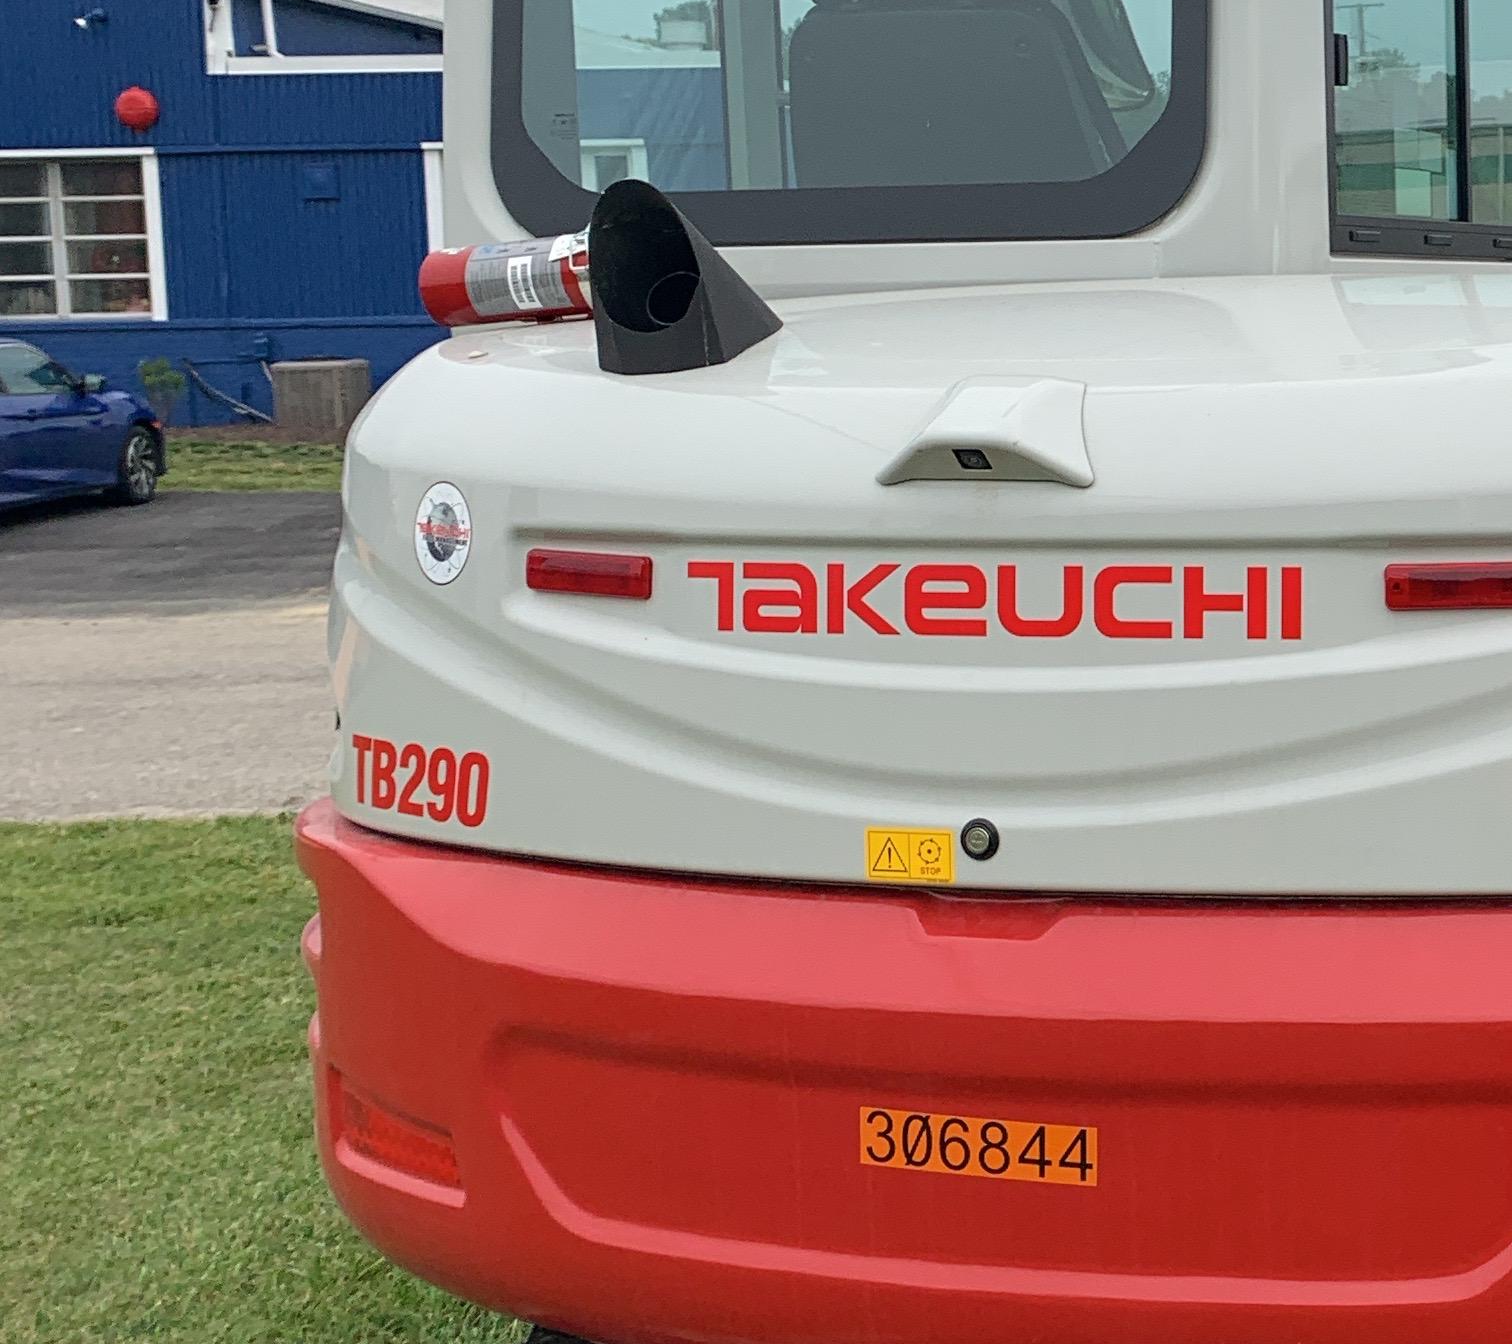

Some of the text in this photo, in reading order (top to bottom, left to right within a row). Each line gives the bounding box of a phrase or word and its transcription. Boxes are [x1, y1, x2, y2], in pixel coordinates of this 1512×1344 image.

[352, 734, 490, 828] TB290
[920, 866, 942, 876] STOP
[866, 1109, 1094, 1182] 306844
